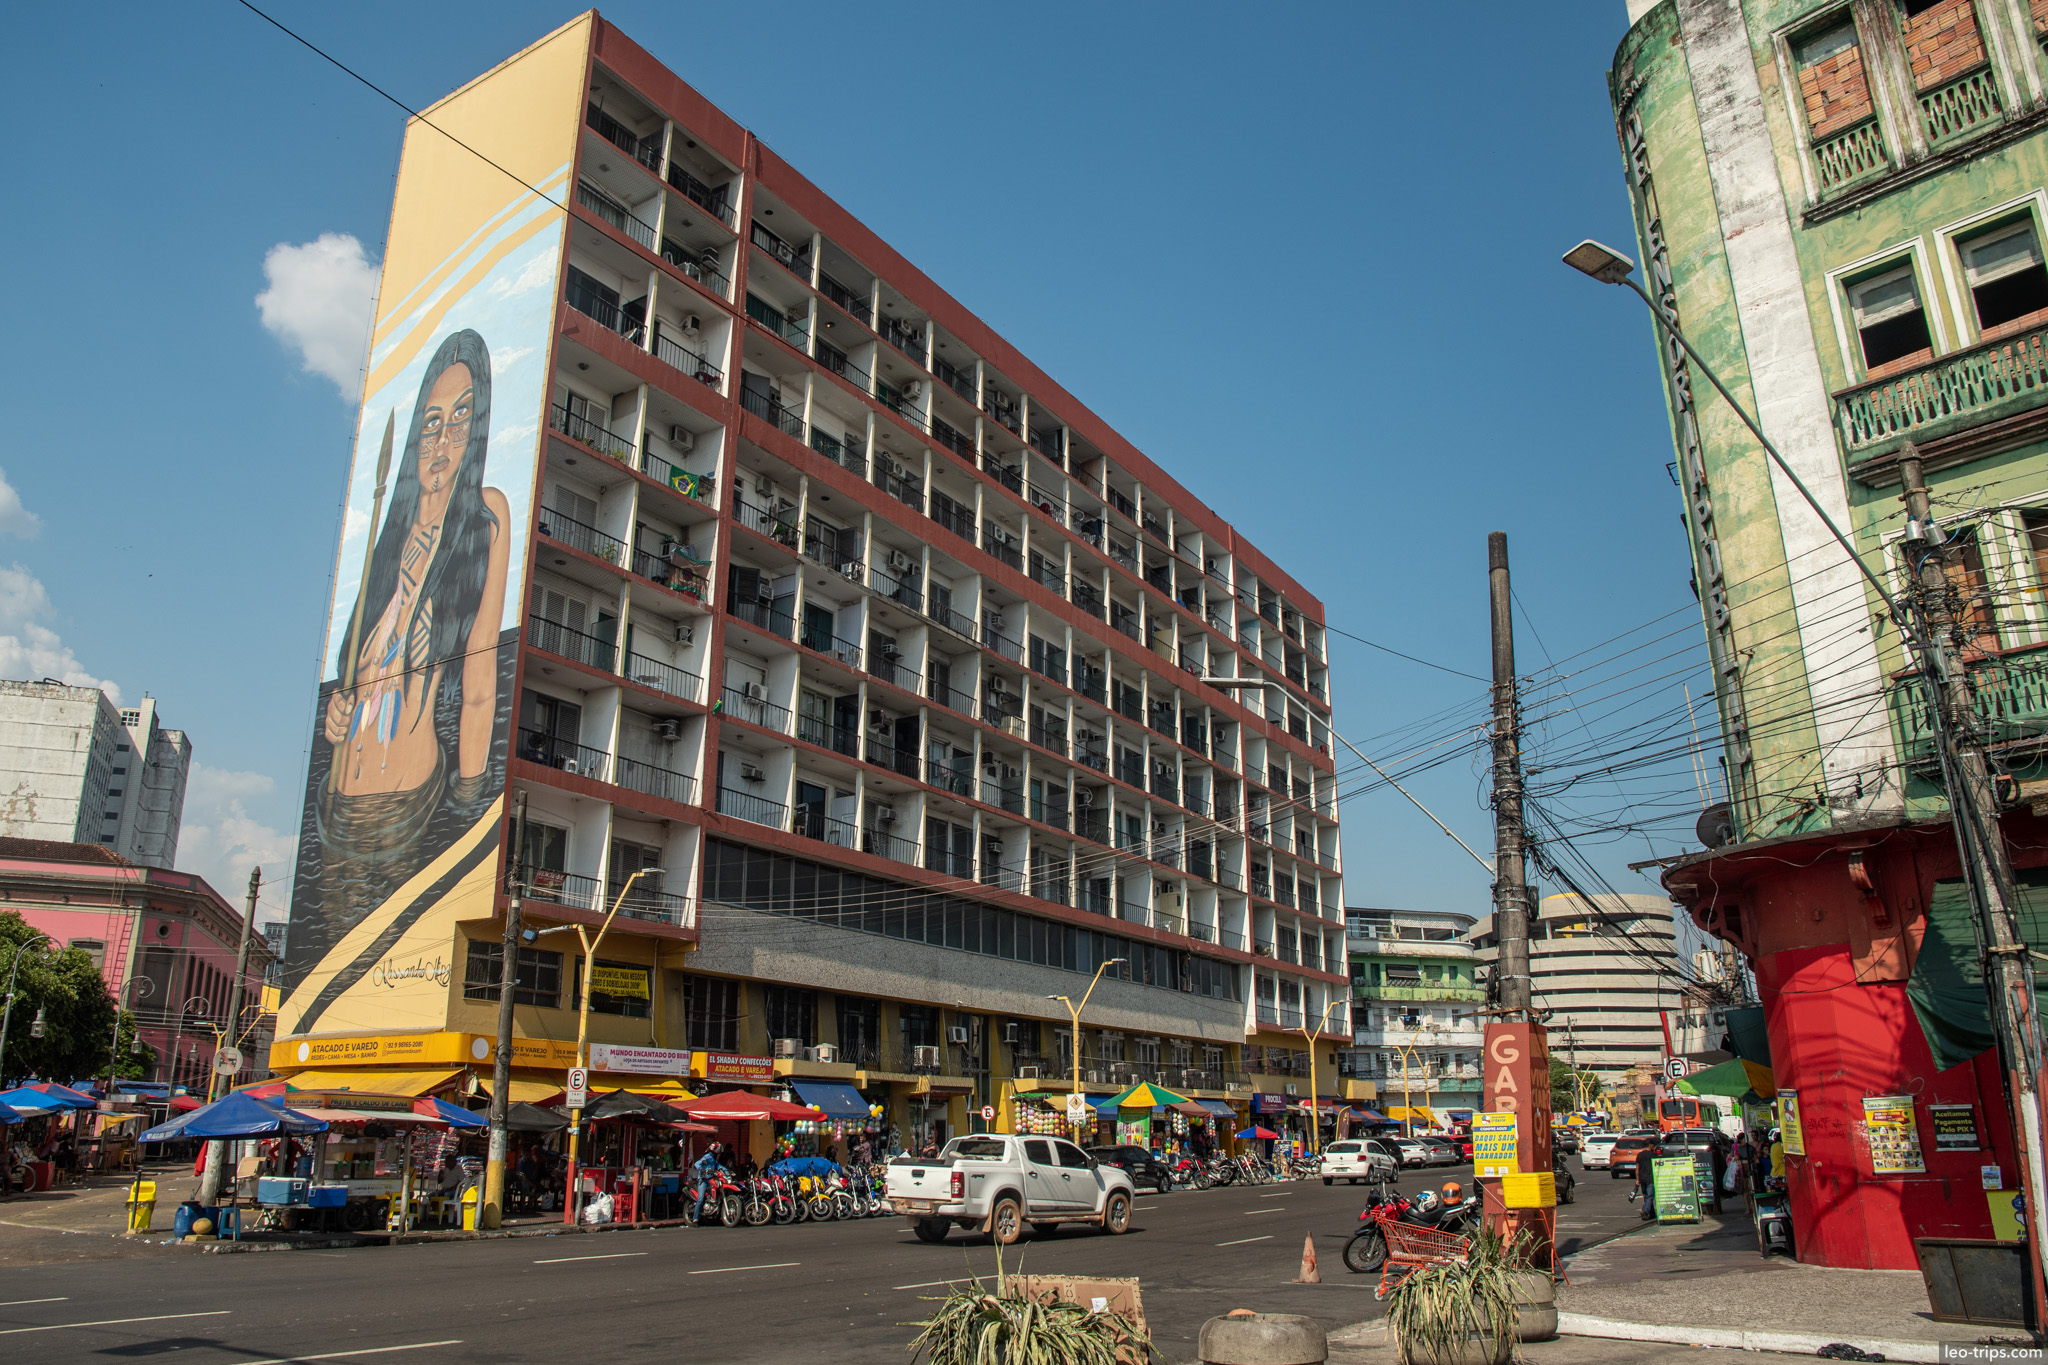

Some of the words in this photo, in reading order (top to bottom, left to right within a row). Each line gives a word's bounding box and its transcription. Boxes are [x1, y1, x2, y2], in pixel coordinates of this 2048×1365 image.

[312, 1043, 345, 1053] ATACADO
[345, 1043, 350, 1052] E
[352, 1041, 379, 1051] VAREJO
[634, 1050, 667, 1058] ENCANTADO
[717, 1056, 738, 1064] SHADAY
[740, 1058, 772, 1067] CONFECÇÕES
[715, 1065, 740, 1073] ATACADO
[1671, 1063, 1682, 1077] E
[574, 1073, 581, 1087] E
[330, 1098, 353, 1106] PASTEL
[985, 1108, 991, 1117] E
[1475, 1143, 1498, 1151] MAIS
[1501, 1143, 1515, 1151] UM
